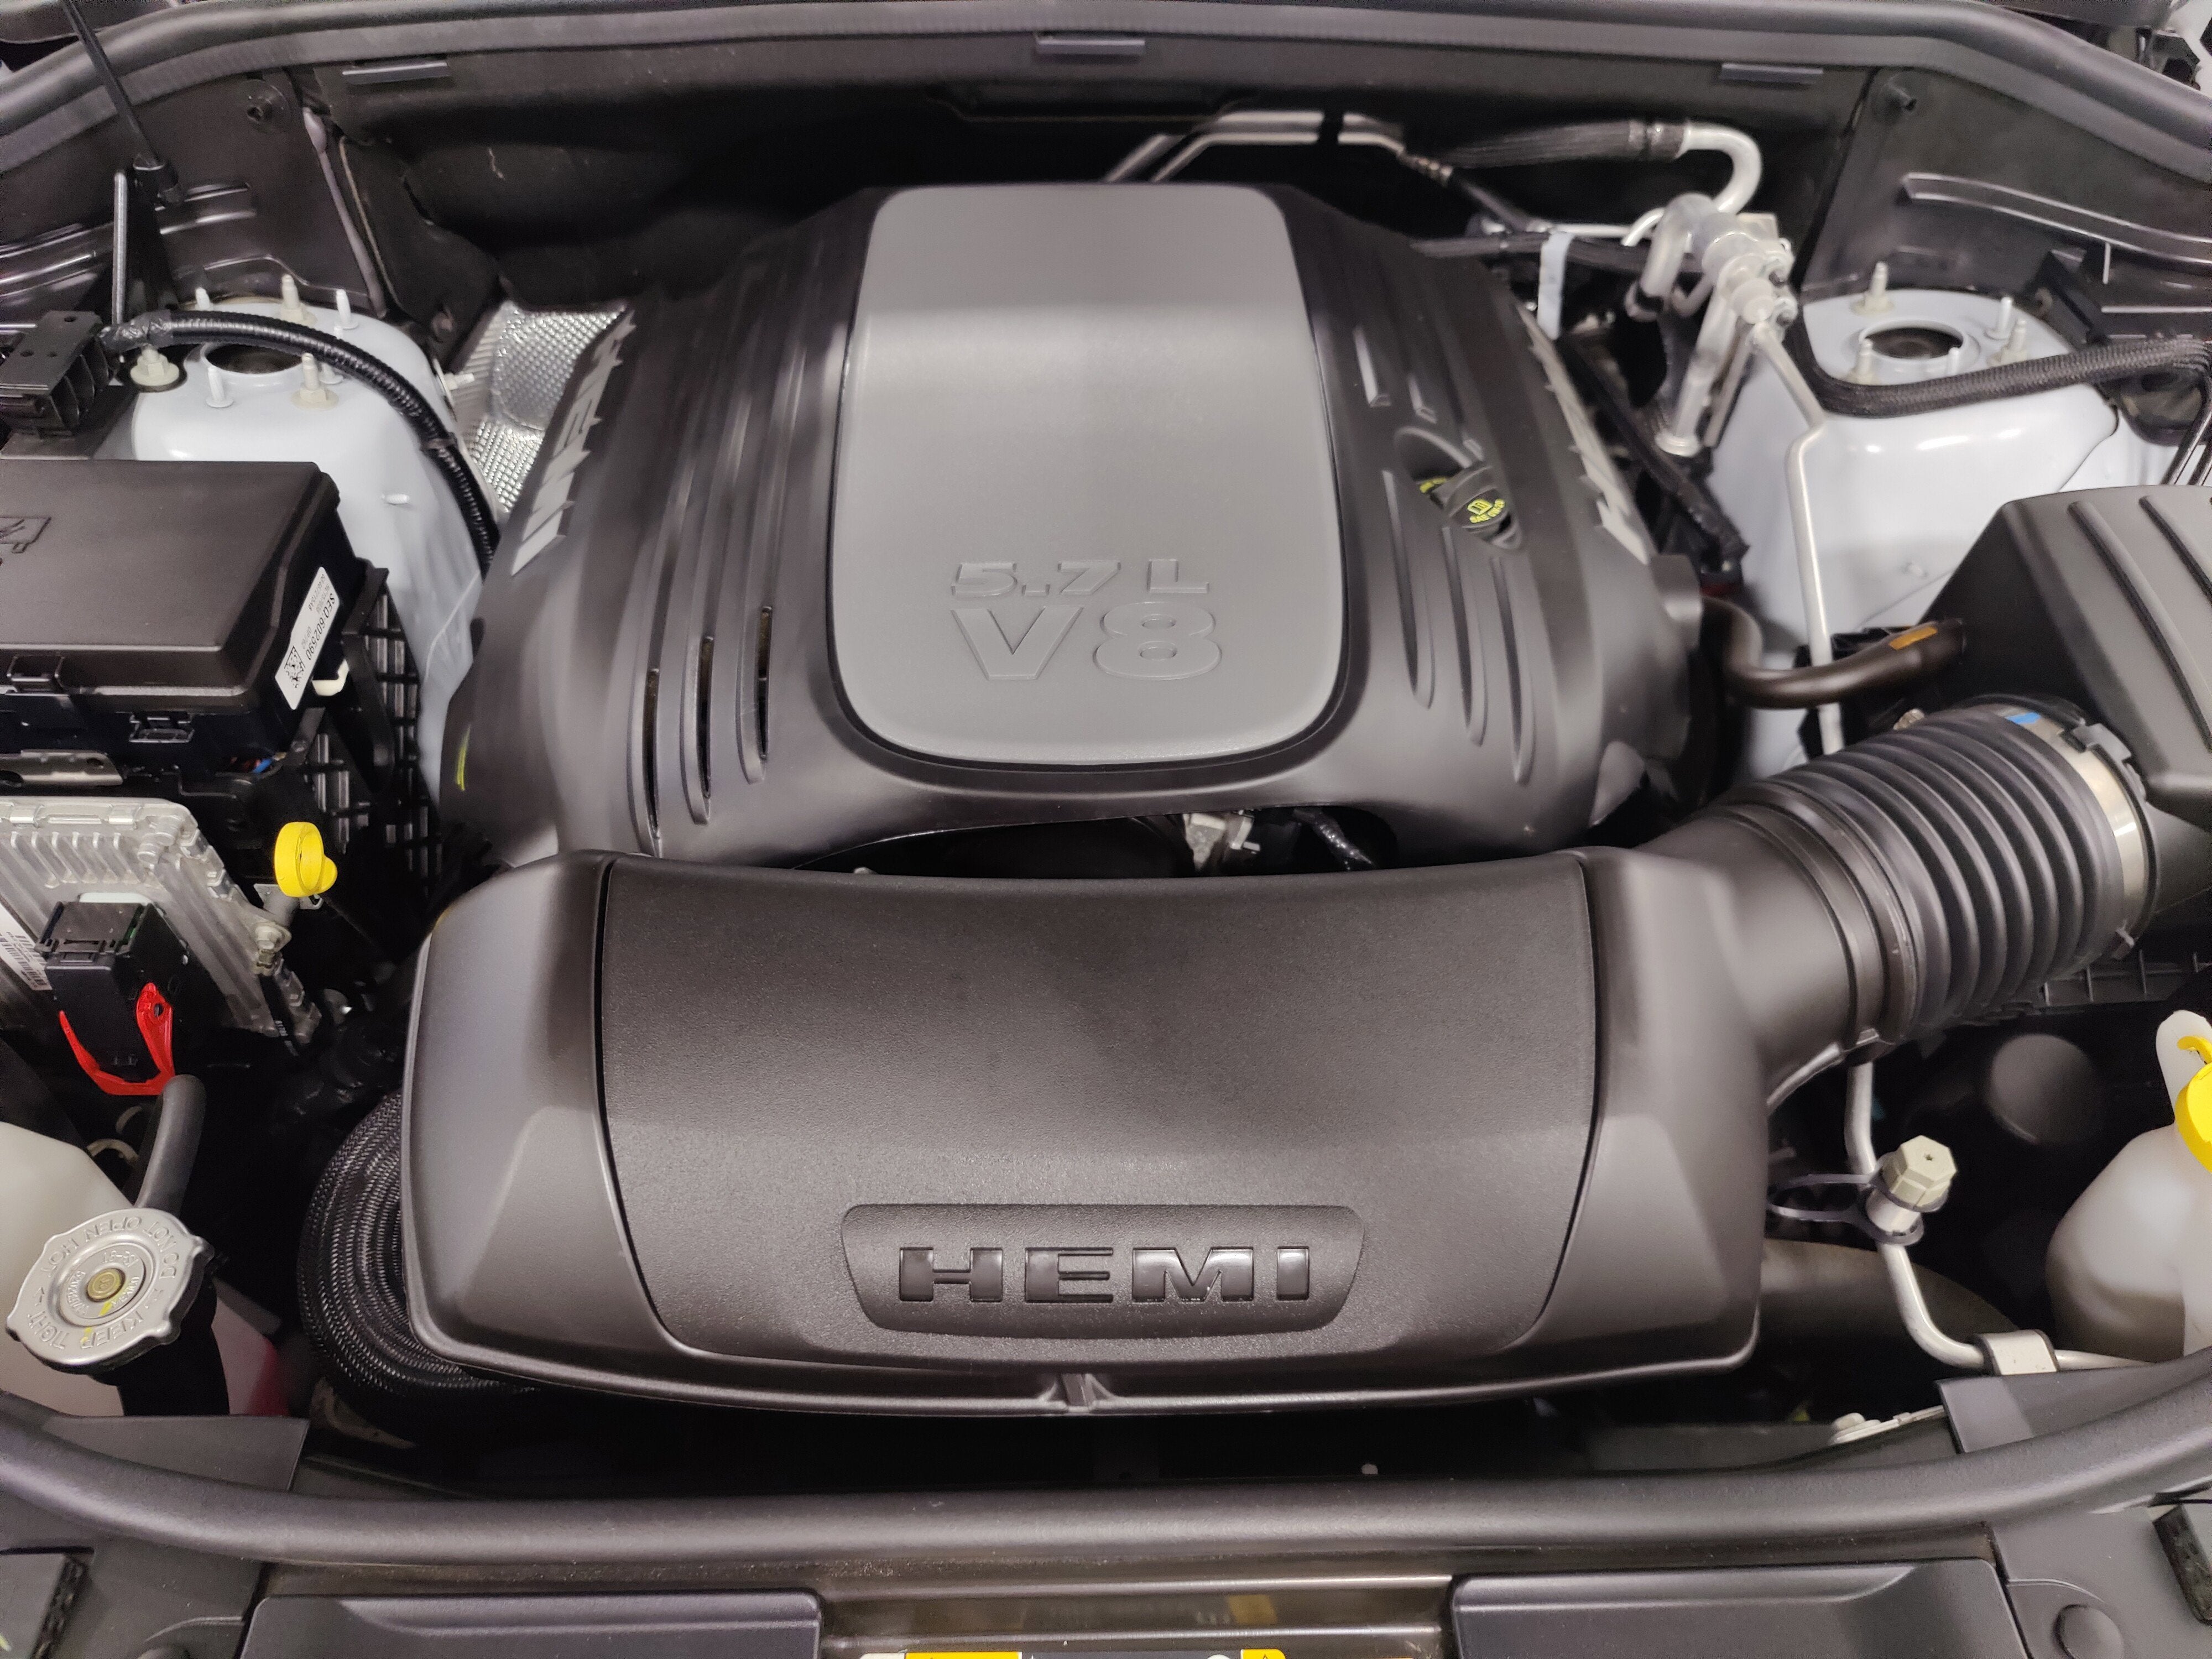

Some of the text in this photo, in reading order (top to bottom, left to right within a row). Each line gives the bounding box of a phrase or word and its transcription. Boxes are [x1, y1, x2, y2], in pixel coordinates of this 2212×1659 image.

[951, 561, 1121, 598] 5.7
[951, 601, 1222, 681] V8
[84, 1216, 142, 1243] OPEN
[142, 1221, 177, 1253] NOT
[40, 1238, 80, 1278] HOT
[159, 1252, 179, 1279] DO
[899, 1245, 1311, 1303] HEMI
[27, 1310, 144, 1350] KEEP TIGHT
